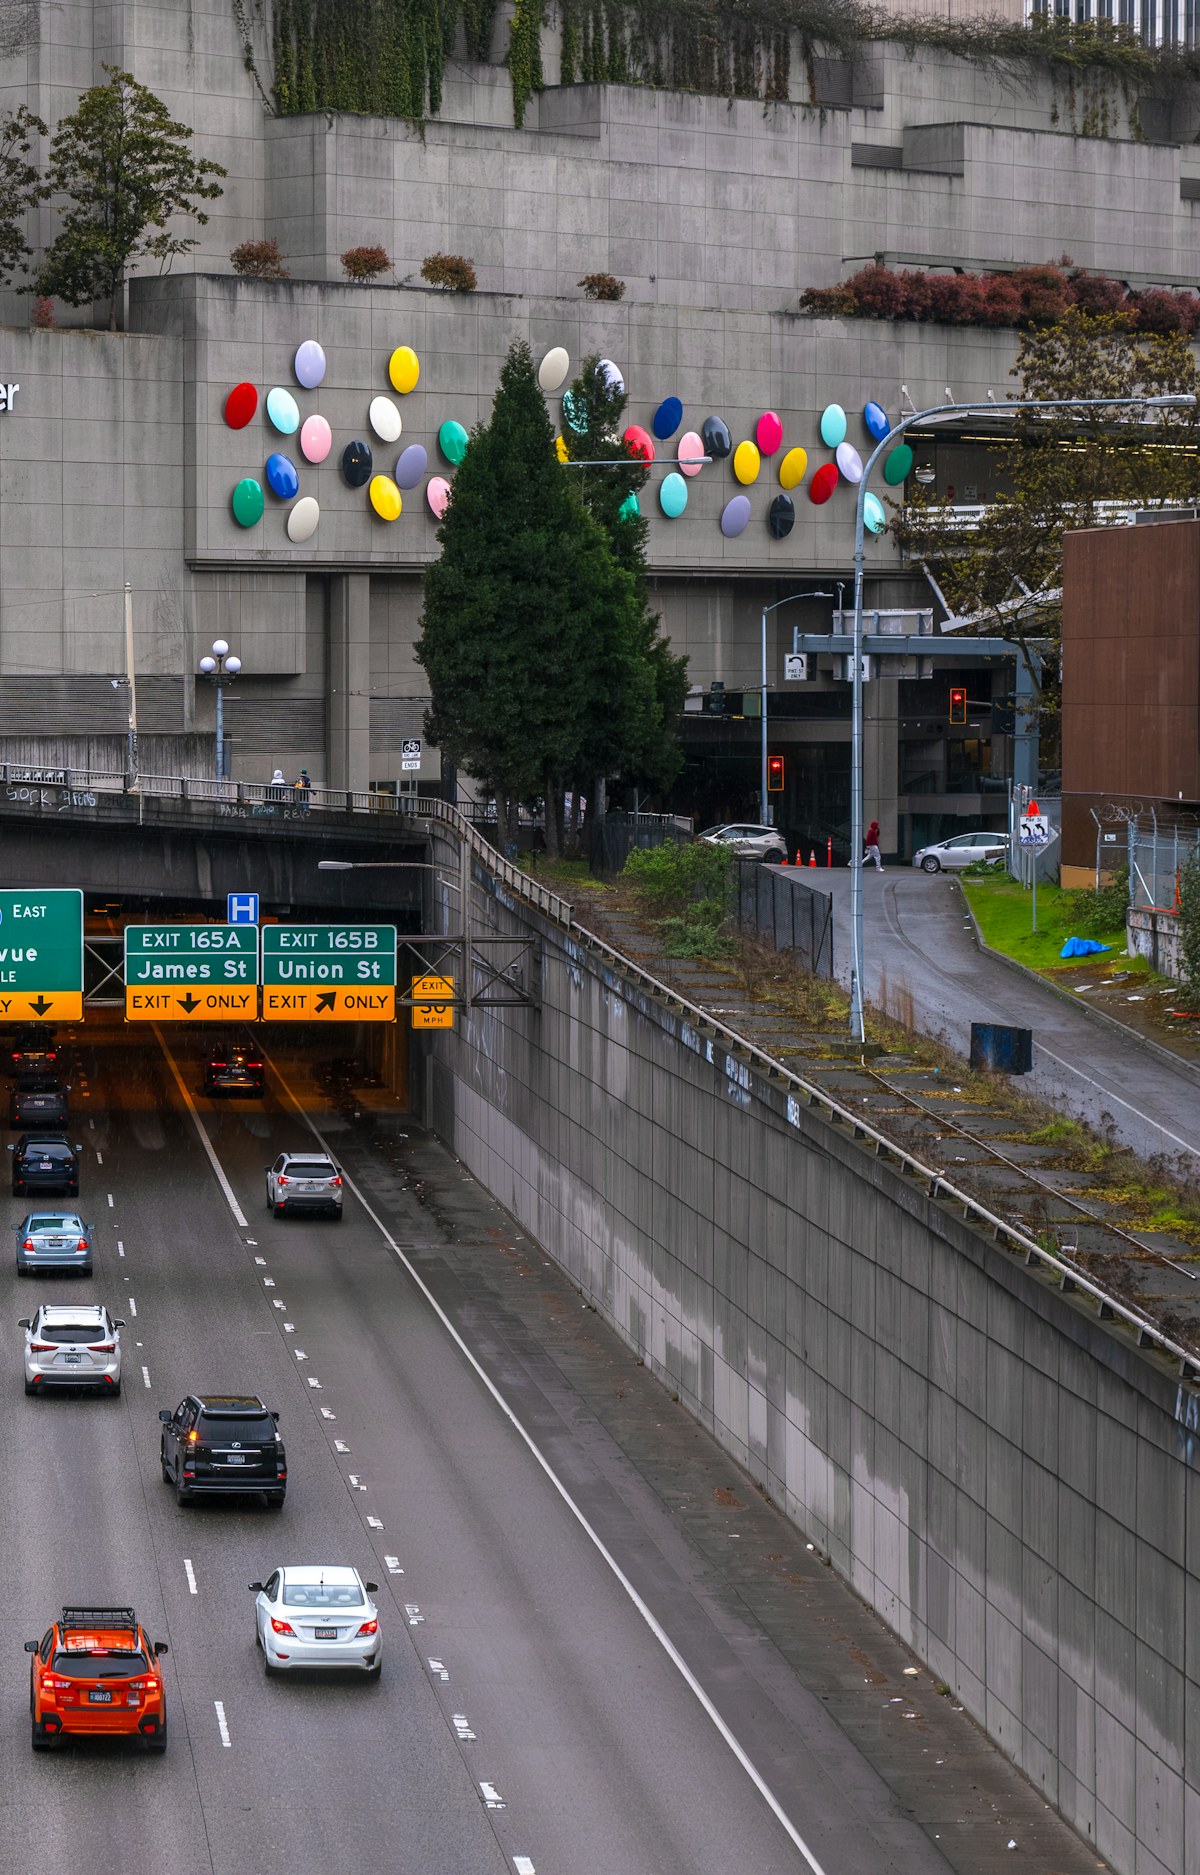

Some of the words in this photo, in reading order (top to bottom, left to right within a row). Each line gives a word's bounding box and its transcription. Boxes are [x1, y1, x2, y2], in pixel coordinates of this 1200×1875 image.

[13, 904, 47, 918] EAST
[232, 897, 255, 921] H
[142, 933, 181, 947] EXIT
[189, 931, 241, 948] 165A
[280, 933, 318, 947] EXIT
[328, 931, 378, 949] 165B
[137, 961, 211, 978] James
[223, 960, 247, 978] St
[278, 960, 343, 978] Union
[356, 960, 380, 978] St
[422, 981, 444, 990] EXIT
[132, 995, 170, 1008] EXIT
[206, 995, 250, 1008] ONLY
[269, 995, 307, 1008] EXIT
[344, 995, 388, 1009] ONLY
